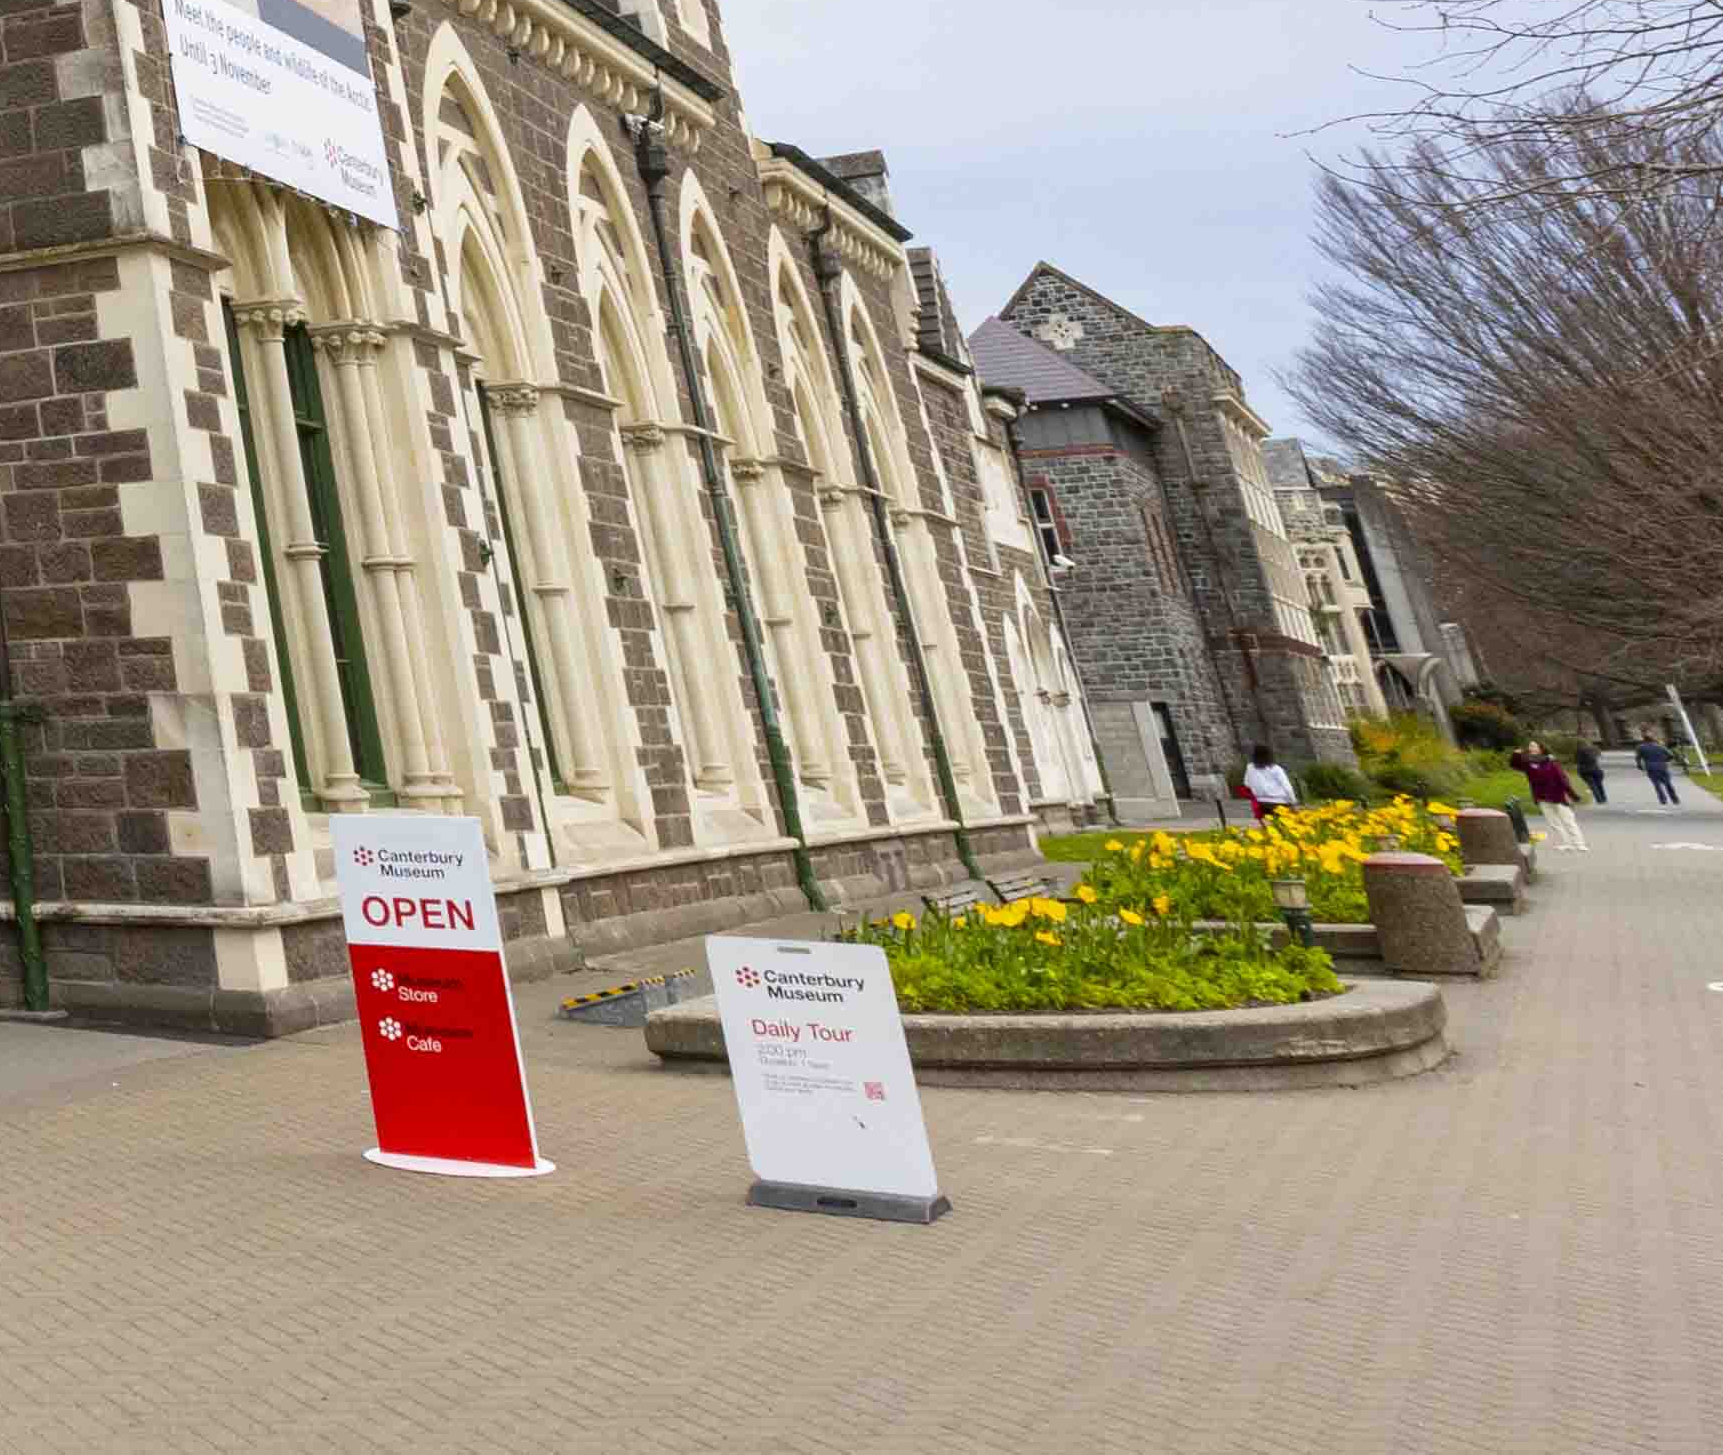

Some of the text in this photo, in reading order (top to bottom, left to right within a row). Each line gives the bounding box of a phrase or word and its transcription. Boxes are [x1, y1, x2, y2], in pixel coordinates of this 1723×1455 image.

[204, 9, 224, 39] the
[226, 25, 261, 59] people
[179, 33, 271, 95] Until 3 November
[378, 849, 463, 866] Canterbury
[380, 864, 445, 879] Museum
[362, 896, 475, 930] OPEN
[763, 969, 864, 992] Canterbury
[398, 986, 438, 1003] Store
[767, 986, 844, 1002] Museum
[752, 1017, 853, 1043] Daily Tour
